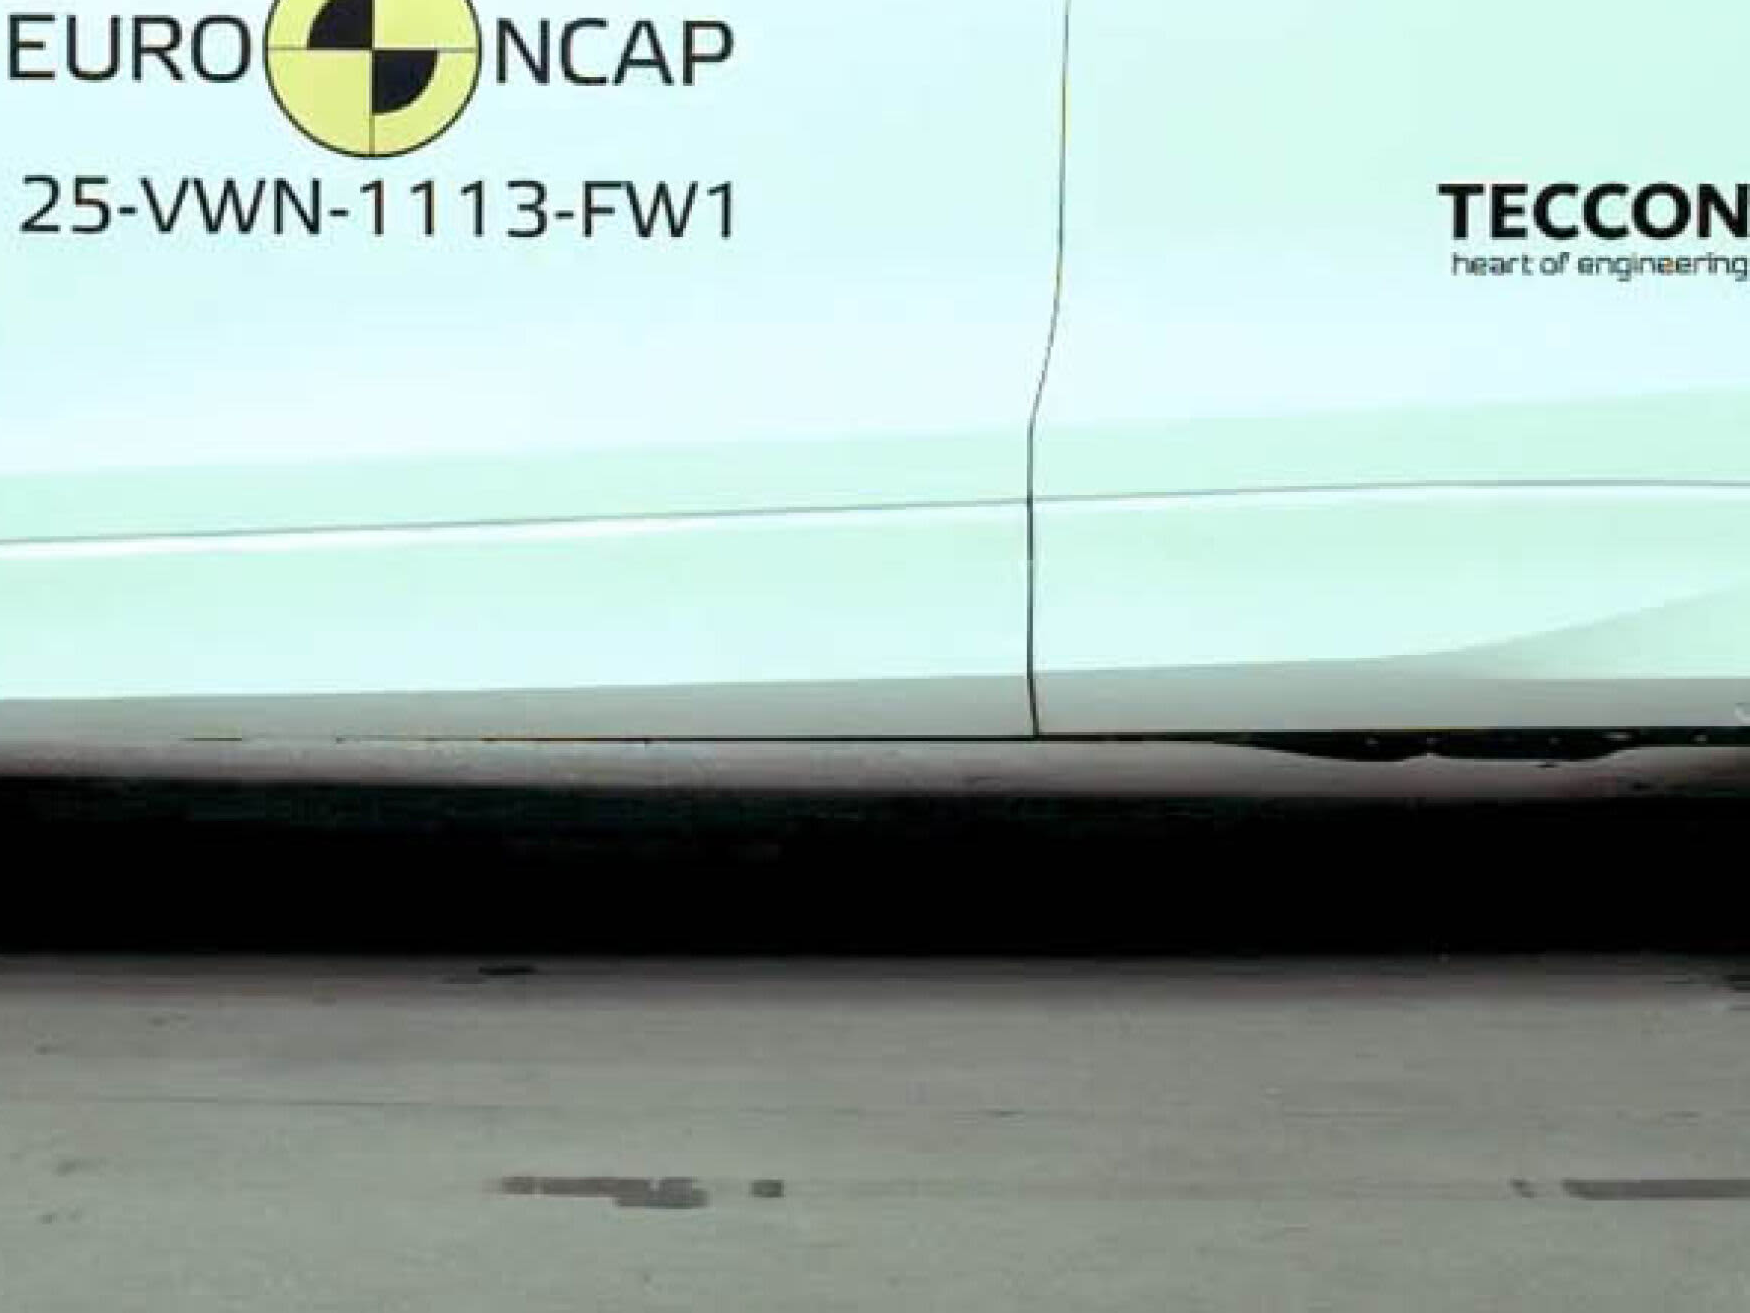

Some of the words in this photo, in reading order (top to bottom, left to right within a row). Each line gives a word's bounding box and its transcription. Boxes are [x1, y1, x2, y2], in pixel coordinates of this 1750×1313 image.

[8, 12, 251, 82] EURO
[496, 18, 736, 86] NCAP
[20, 173, 734, 239] 25-VWN-1113-FW1
[1437, 182, 1750, 240] TECCON
[1452, 251, 1533, 276] heart
[1539, 251, 1570, 276] of
[1577, 251, 1748, 282] engineering
